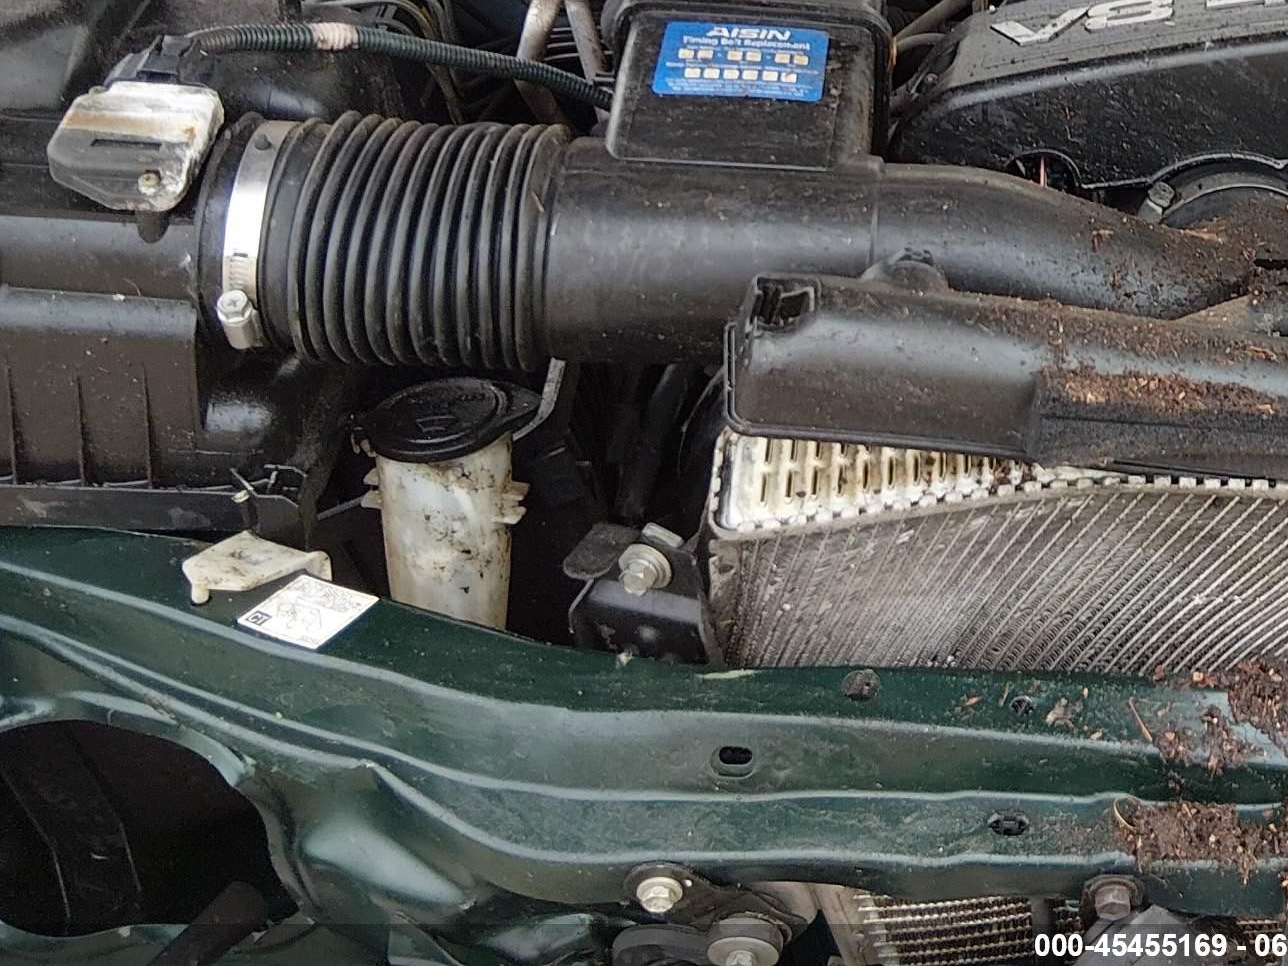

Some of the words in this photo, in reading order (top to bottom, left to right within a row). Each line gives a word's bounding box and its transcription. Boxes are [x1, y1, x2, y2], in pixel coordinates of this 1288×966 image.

[706, 26, 791, 40] AISIN
[683, 35, 718, 46] Timing
[744, 39, 811, 51] Replacement
